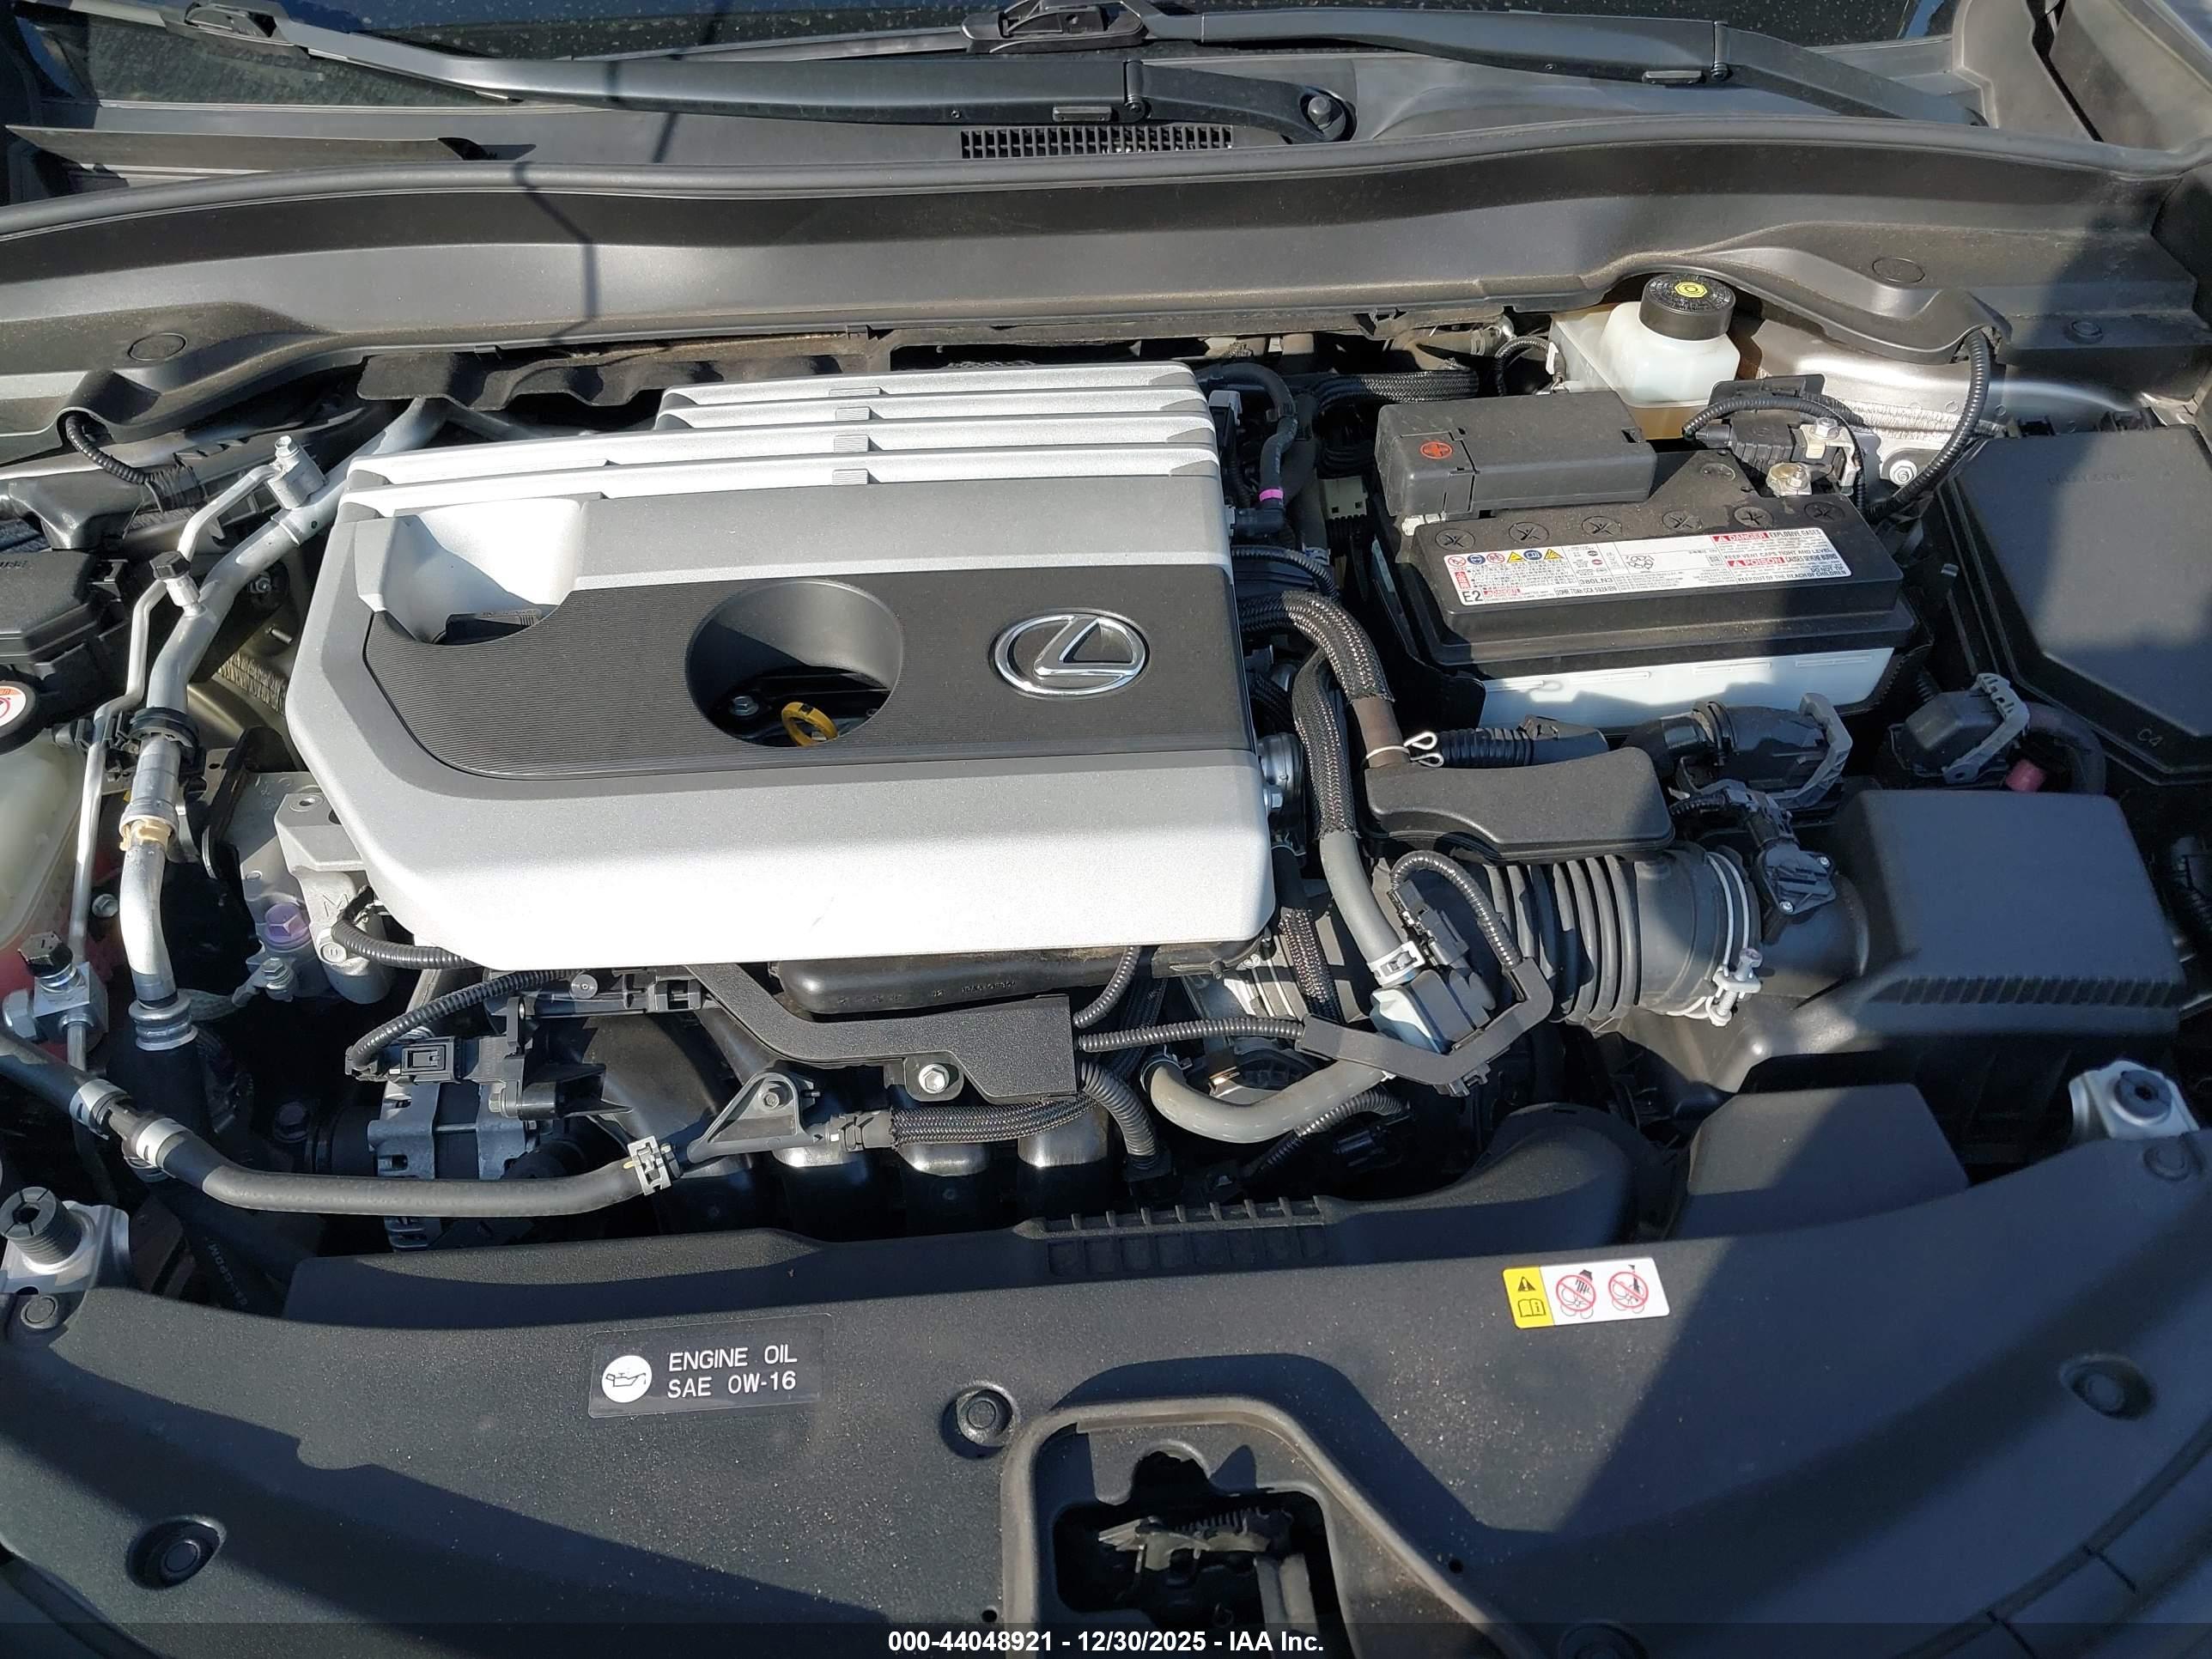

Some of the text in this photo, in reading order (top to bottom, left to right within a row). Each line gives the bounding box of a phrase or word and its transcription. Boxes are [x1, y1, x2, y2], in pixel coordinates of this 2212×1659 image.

[1729, 532, 1766, 542] DANGER
[1745, 556, 1782, 566] POISON
[1462, 590, 1483, 603] E2
[669, 1344, 798, 1372] ENGINE OIL
[667, 1370, 797, 1399] SAE 0W-16
